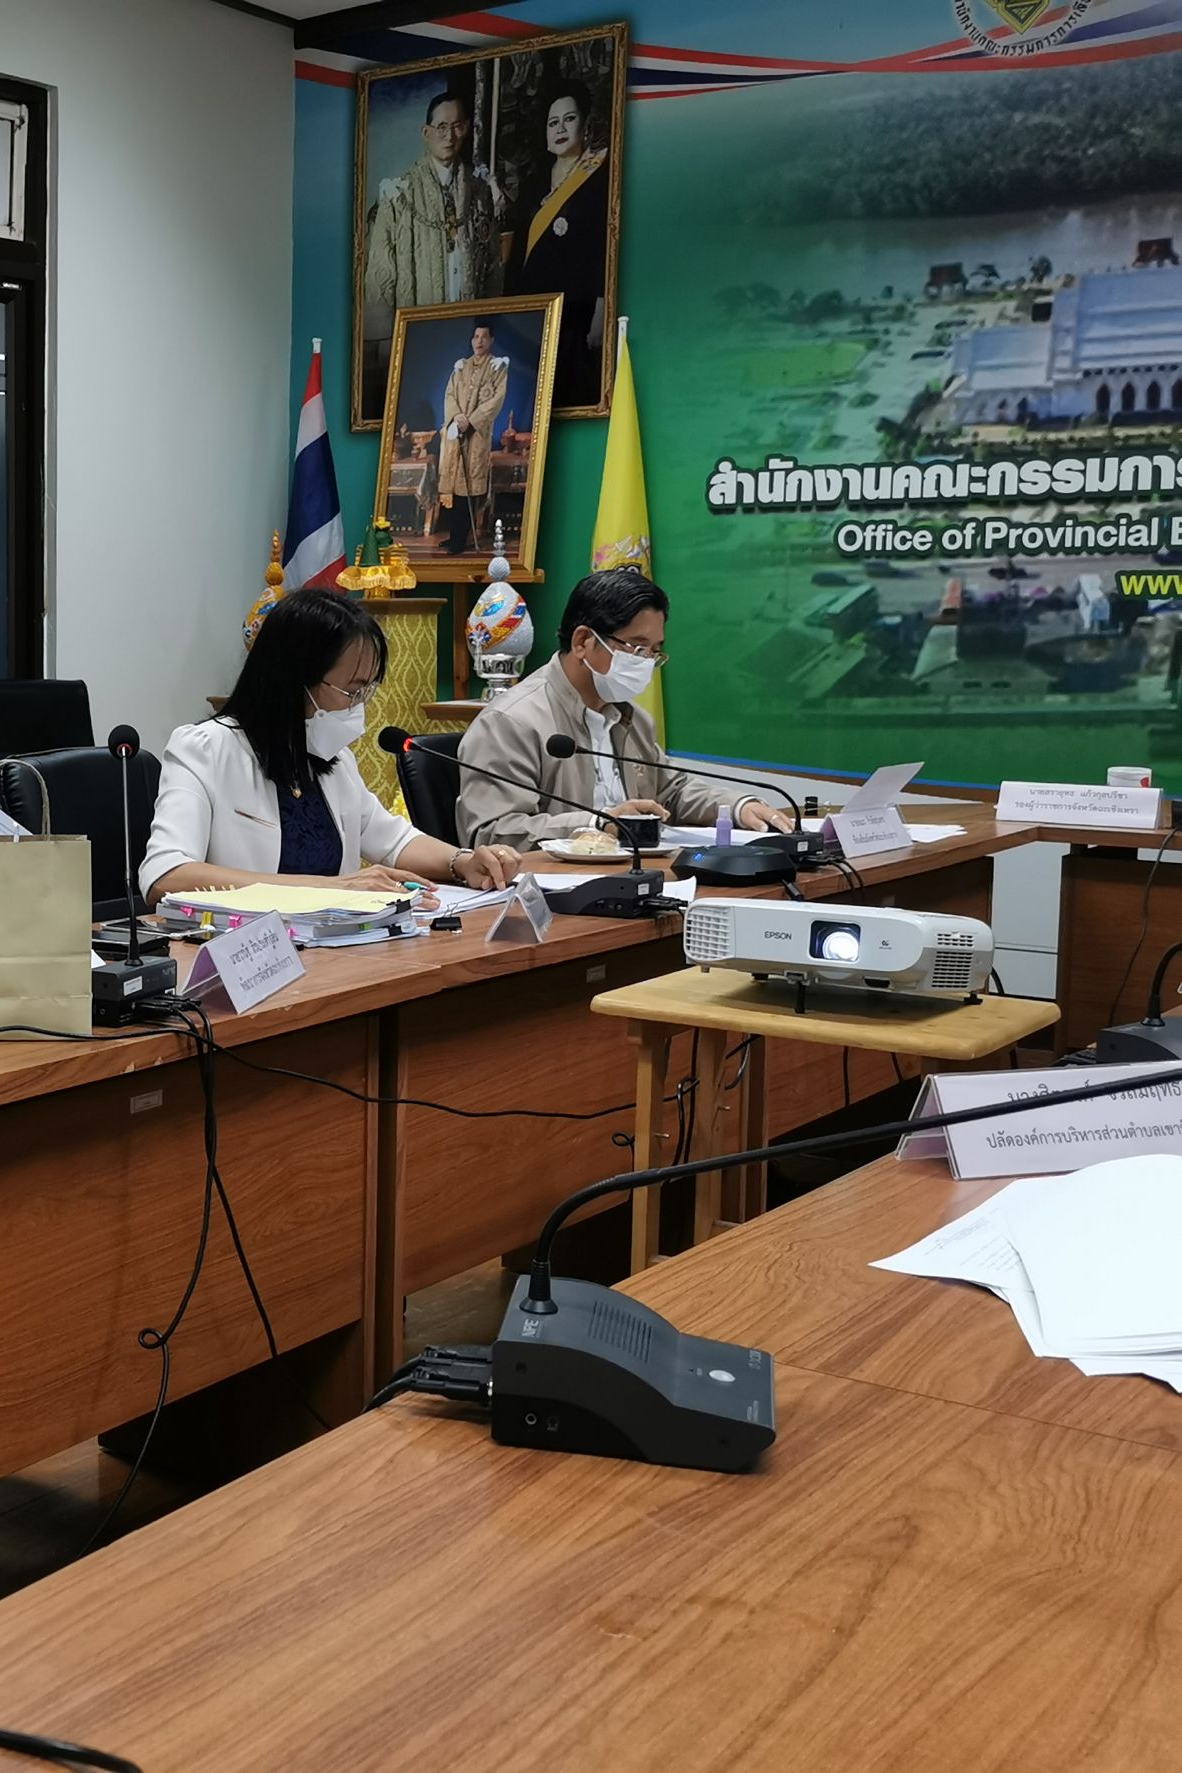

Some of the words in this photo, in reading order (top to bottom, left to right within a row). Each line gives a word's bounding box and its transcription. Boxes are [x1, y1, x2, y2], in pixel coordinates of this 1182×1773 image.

[837, 523, 933, 553] Office
[941, 522, 977, 550] of
[984, 517, 1159, 550] Provincial
[764, 930, 792, 942] EPSON
[985, 1119, 1182, 1150] ปลัดองค์การบริหารส่วนตำบลเขา
